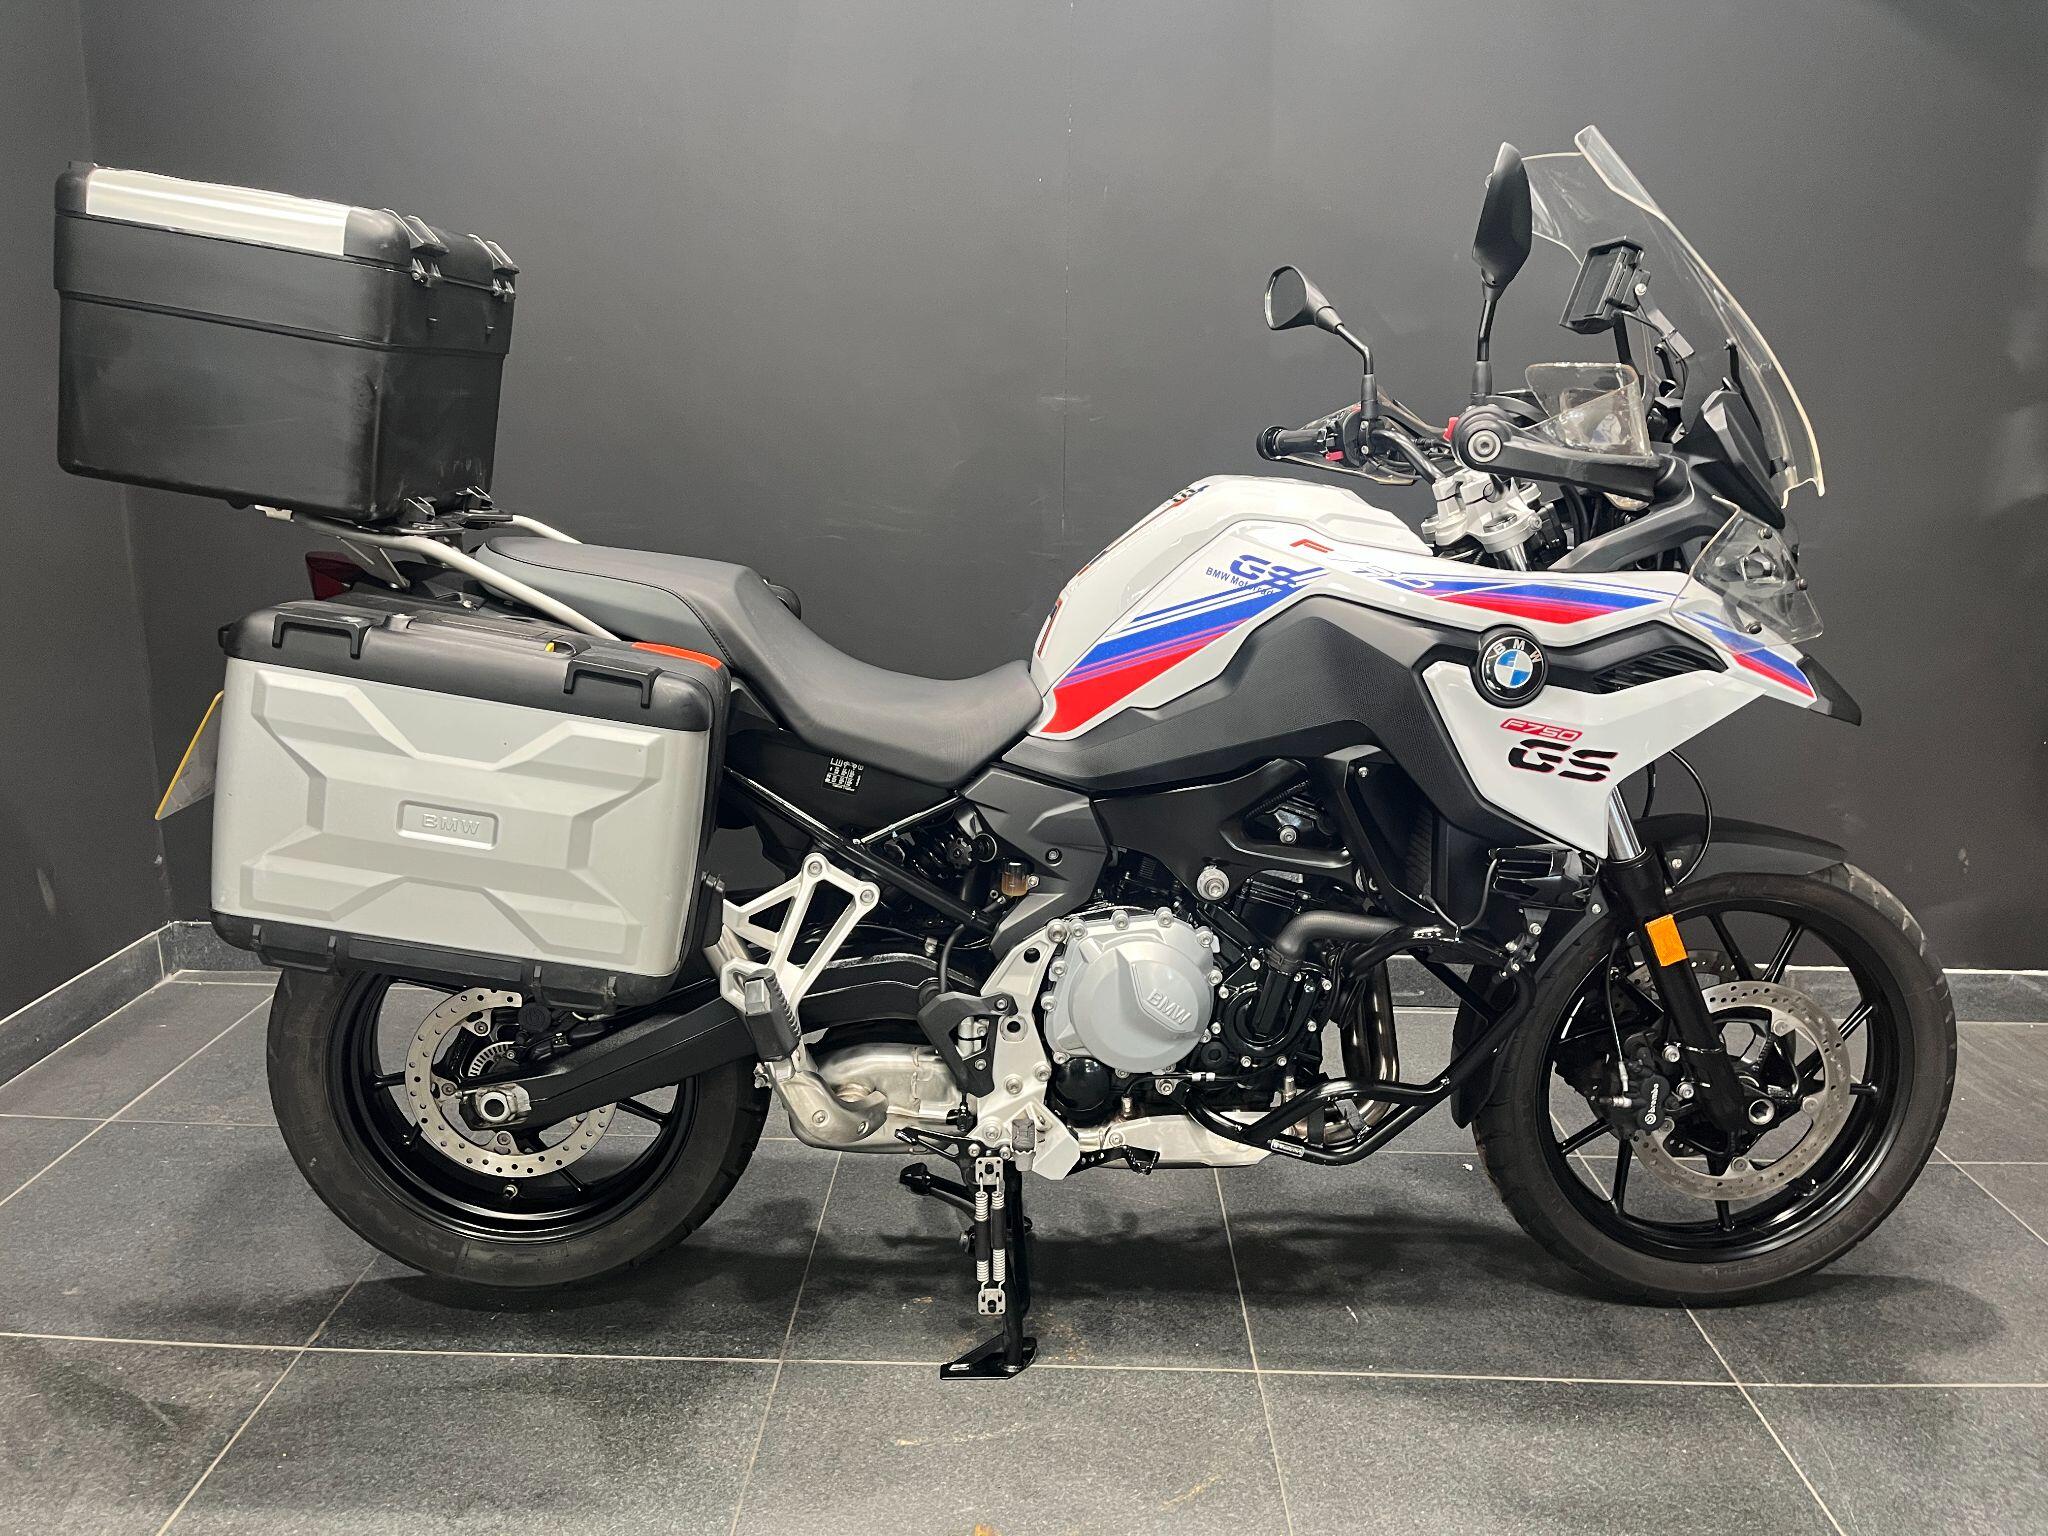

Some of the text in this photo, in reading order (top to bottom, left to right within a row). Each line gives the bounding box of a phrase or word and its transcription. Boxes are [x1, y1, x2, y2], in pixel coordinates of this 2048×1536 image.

[1205, 566, 1230, 582] BMW
[1492, 638, 1543, 664] BMW
[1502, 718, 1582, 742] F750
[1508, 739, 1619, 782] GS
[422, 813, 480, 835] BMW
[1146, 988, 1192, 1024] BMW
[1647, 1083, 1659, 1113] brembo
